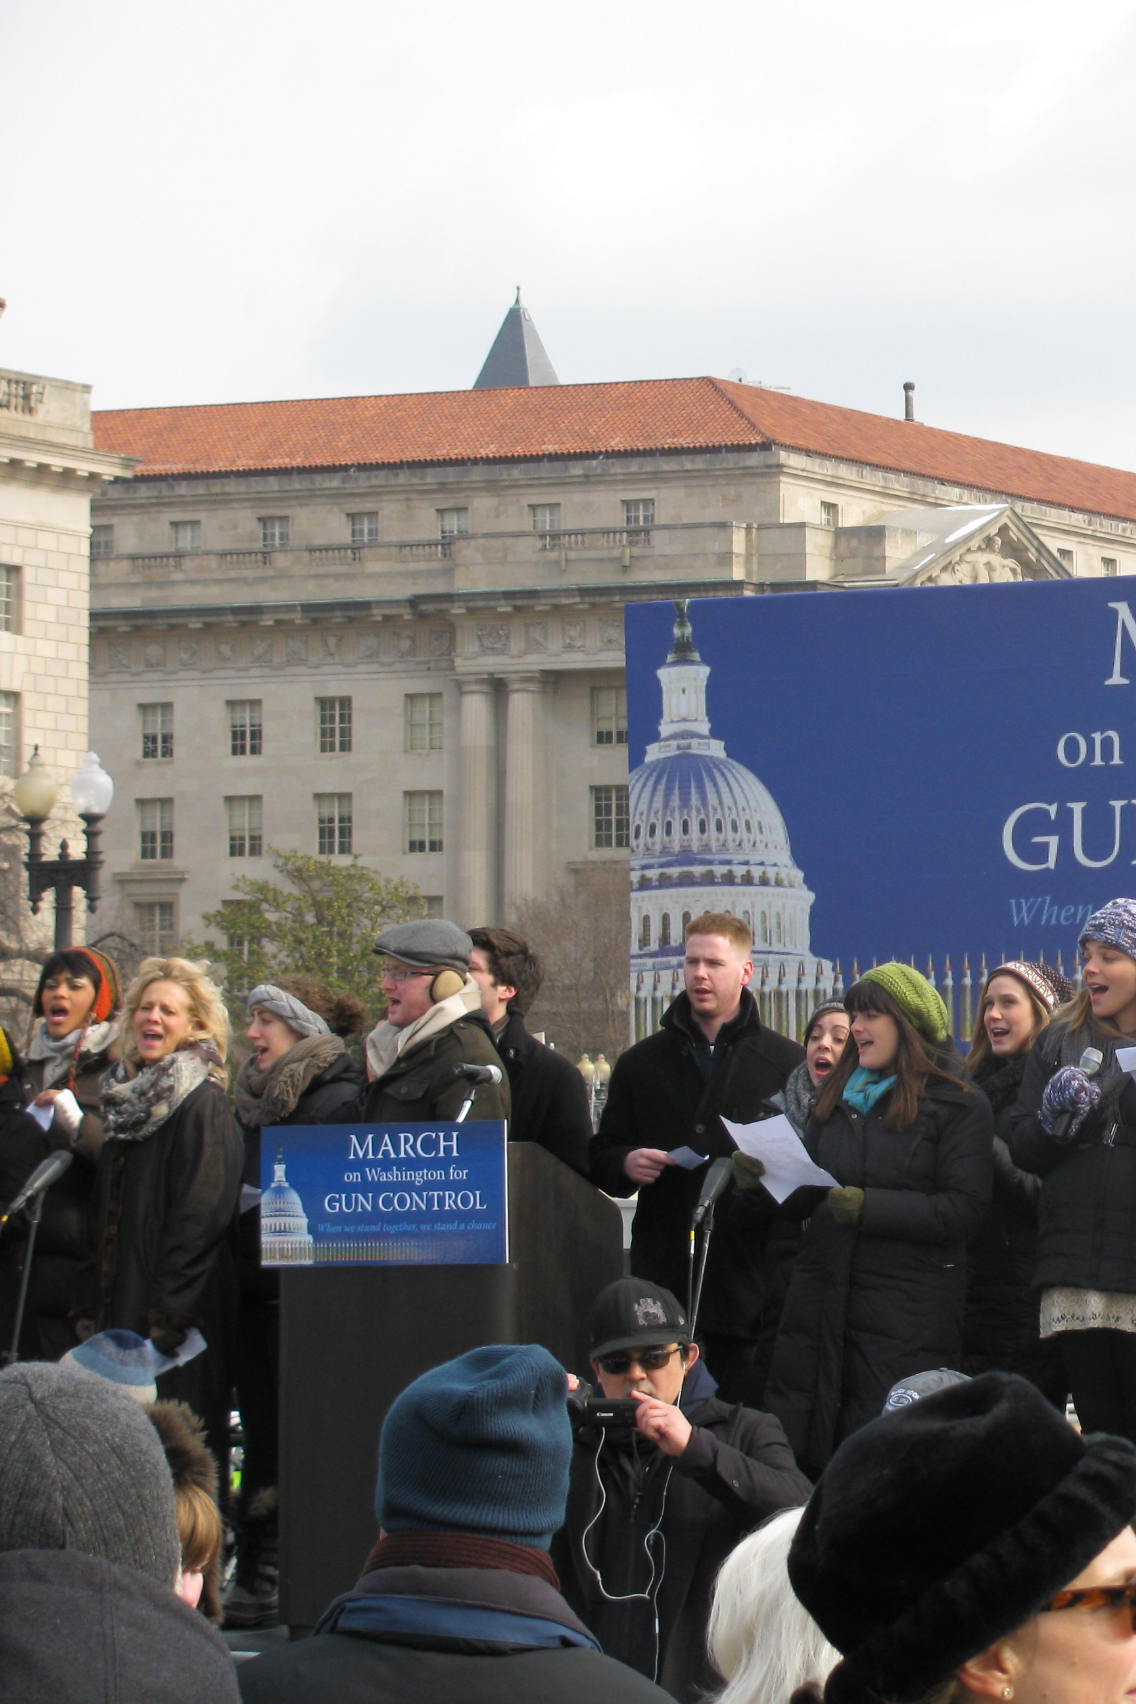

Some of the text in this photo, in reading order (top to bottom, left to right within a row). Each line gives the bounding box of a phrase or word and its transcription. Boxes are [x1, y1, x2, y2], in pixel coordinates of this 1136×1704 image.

[1056, 730, 1124, 768] on
[1009, 895, 1095, 928] When
[348, 1131, 460, 1160] MARCH
[344, 1164, 469, 1186] on Washington for
[324, 1190, 487, 1213] GUN CONTROL
